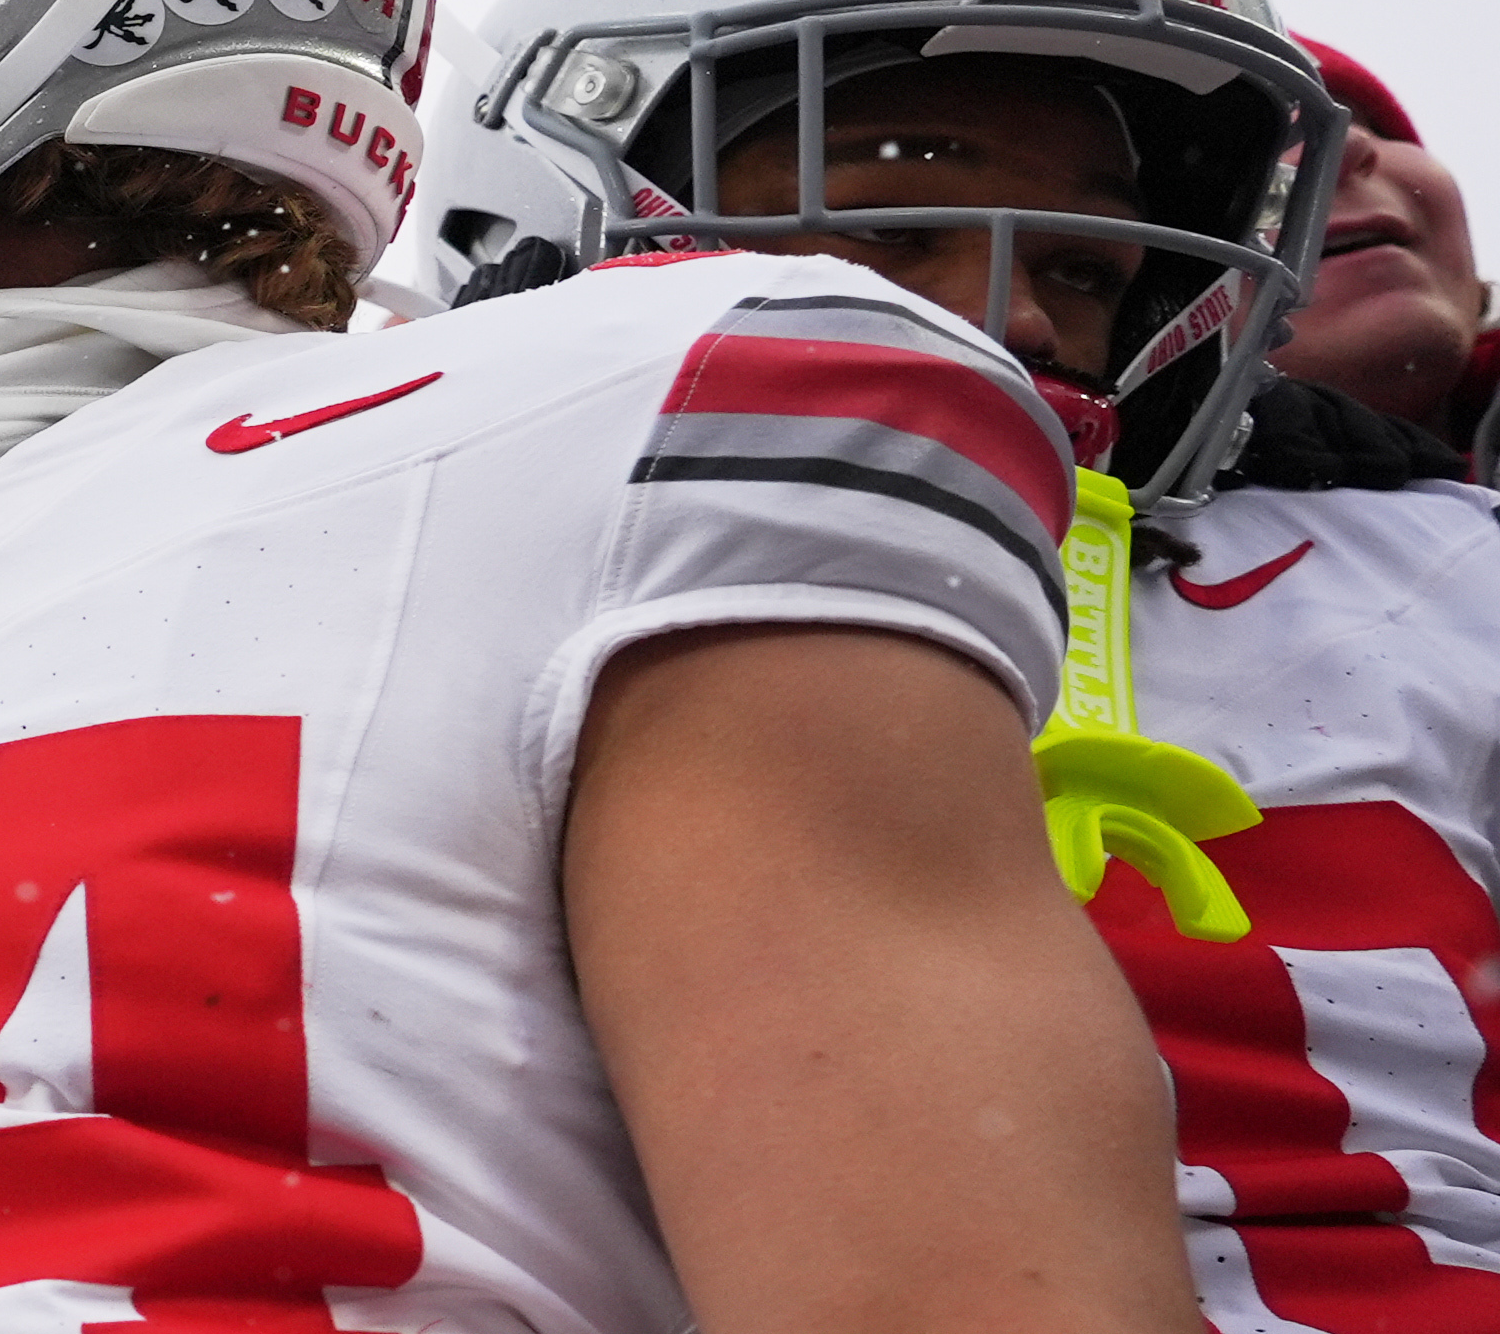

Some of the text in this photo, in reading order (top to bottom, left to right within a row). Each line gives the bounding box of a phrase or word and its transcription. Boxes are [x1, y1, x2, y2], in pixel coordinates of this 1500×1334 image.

[283, 85, 417, 244] BUCK
[633, 187, 684, 218] OHI
[1146, 284, 1234, 375] OHIO STATE
[1065, 535, 1114, 726] BATTLE
